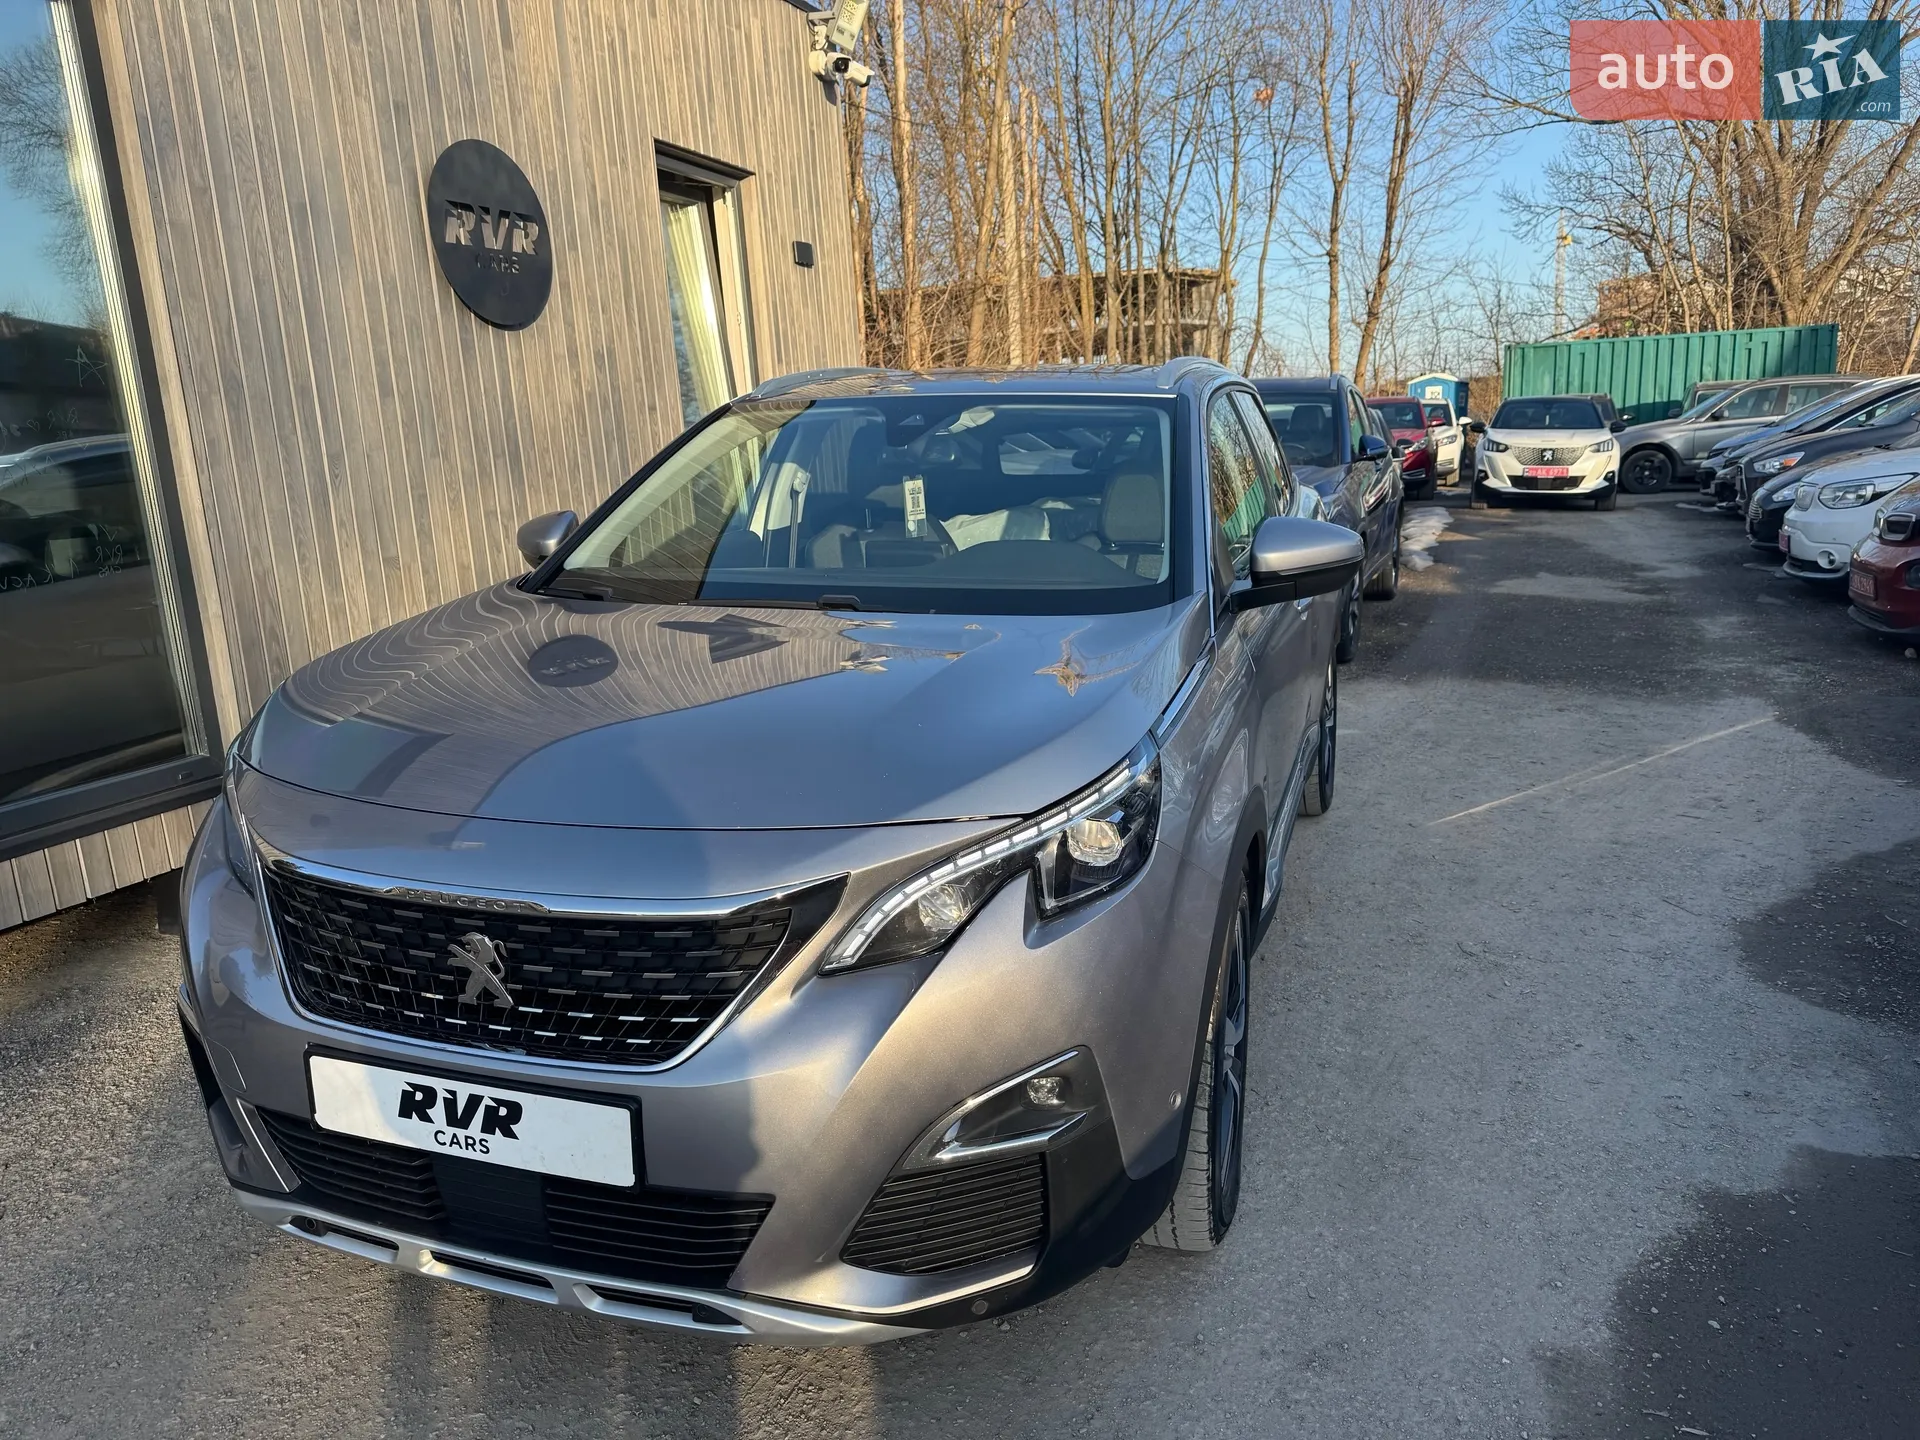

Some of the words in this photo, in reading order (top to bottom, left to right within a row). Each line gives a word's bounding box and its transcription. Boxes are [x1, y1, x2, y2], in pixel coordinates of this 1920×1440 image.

[444, 199, 540, 256] RVR
[405, 889, 526, 913] PEUGEOT
[398, 1081, 523, 1140] RVR
[433, 1129, 491, 1155] CARS
